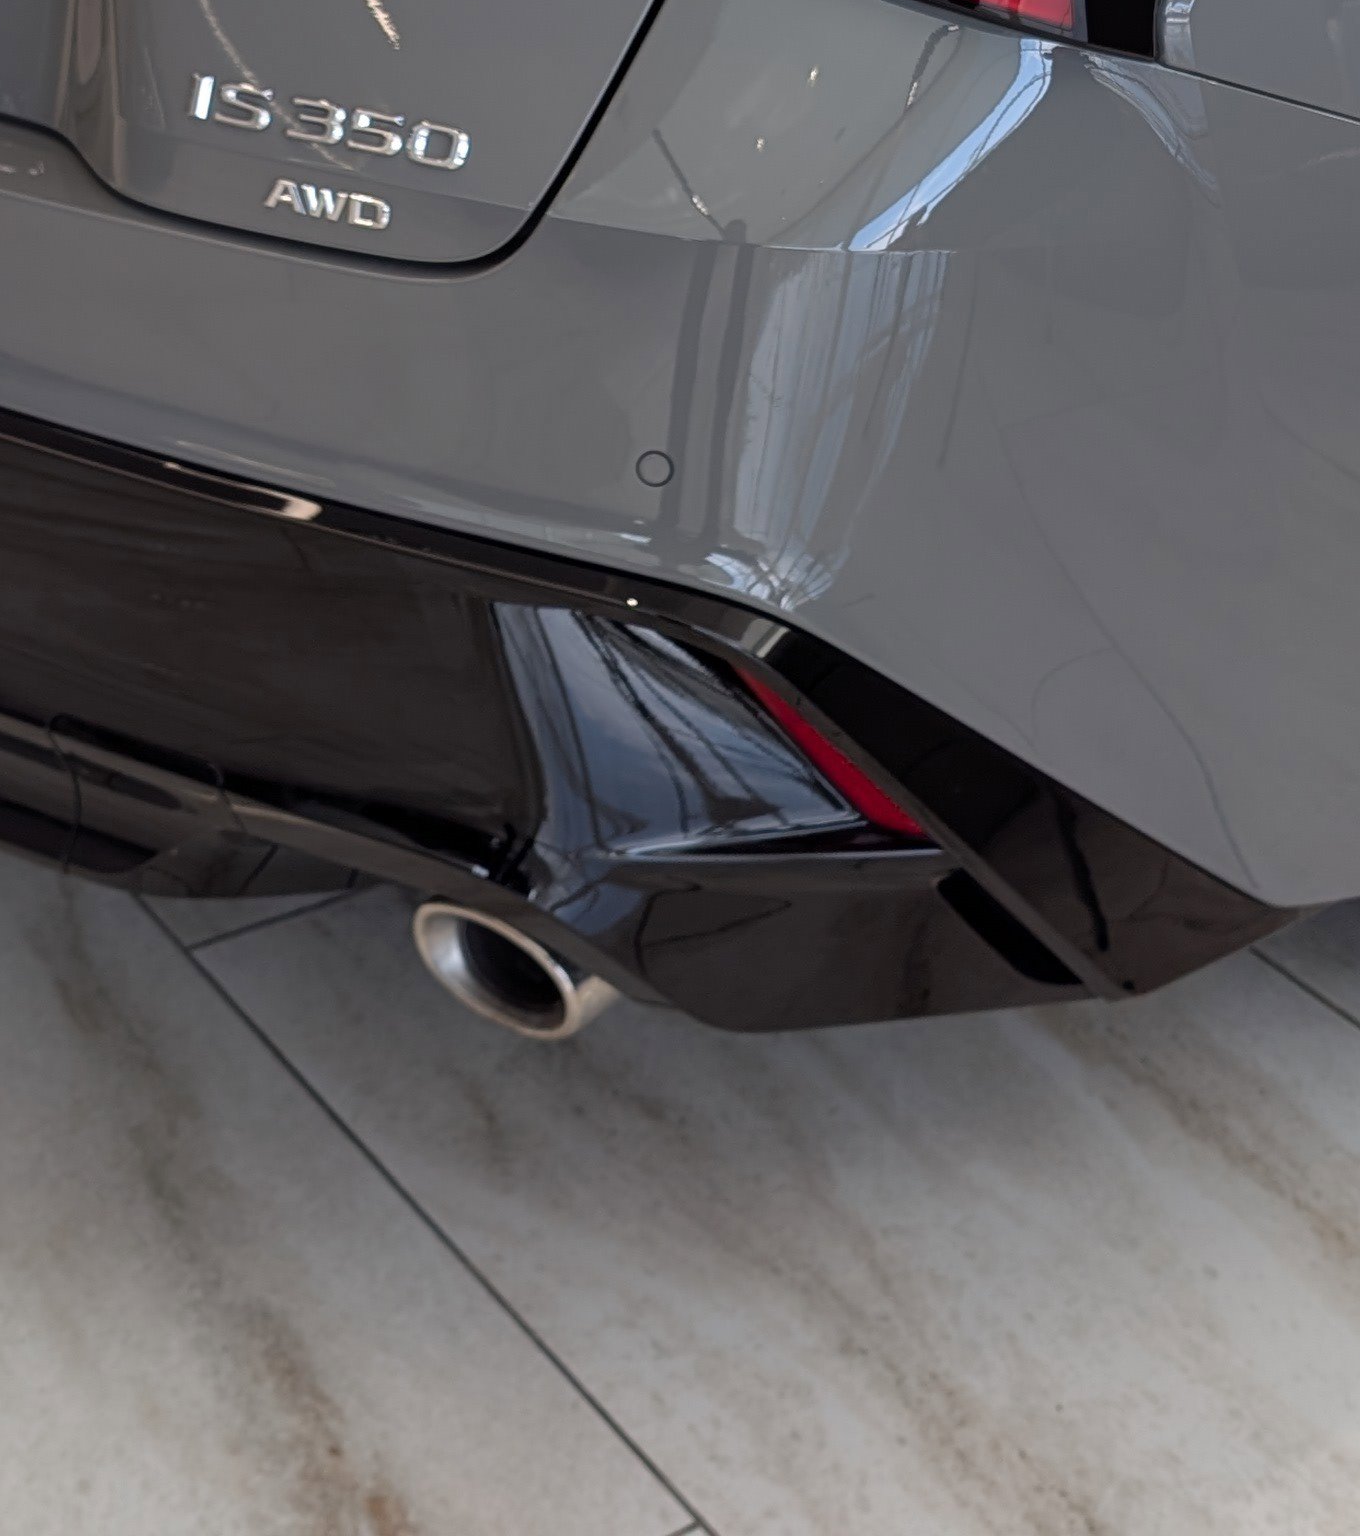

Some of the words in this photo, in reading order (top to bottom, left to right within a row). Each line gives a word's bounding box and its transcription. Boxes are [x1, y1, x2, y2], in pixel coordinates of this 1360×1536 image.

[189, 72, 275, 132] IS
[286, 95, 472, 171] 350
[263, 178, 392, 231] AWD
